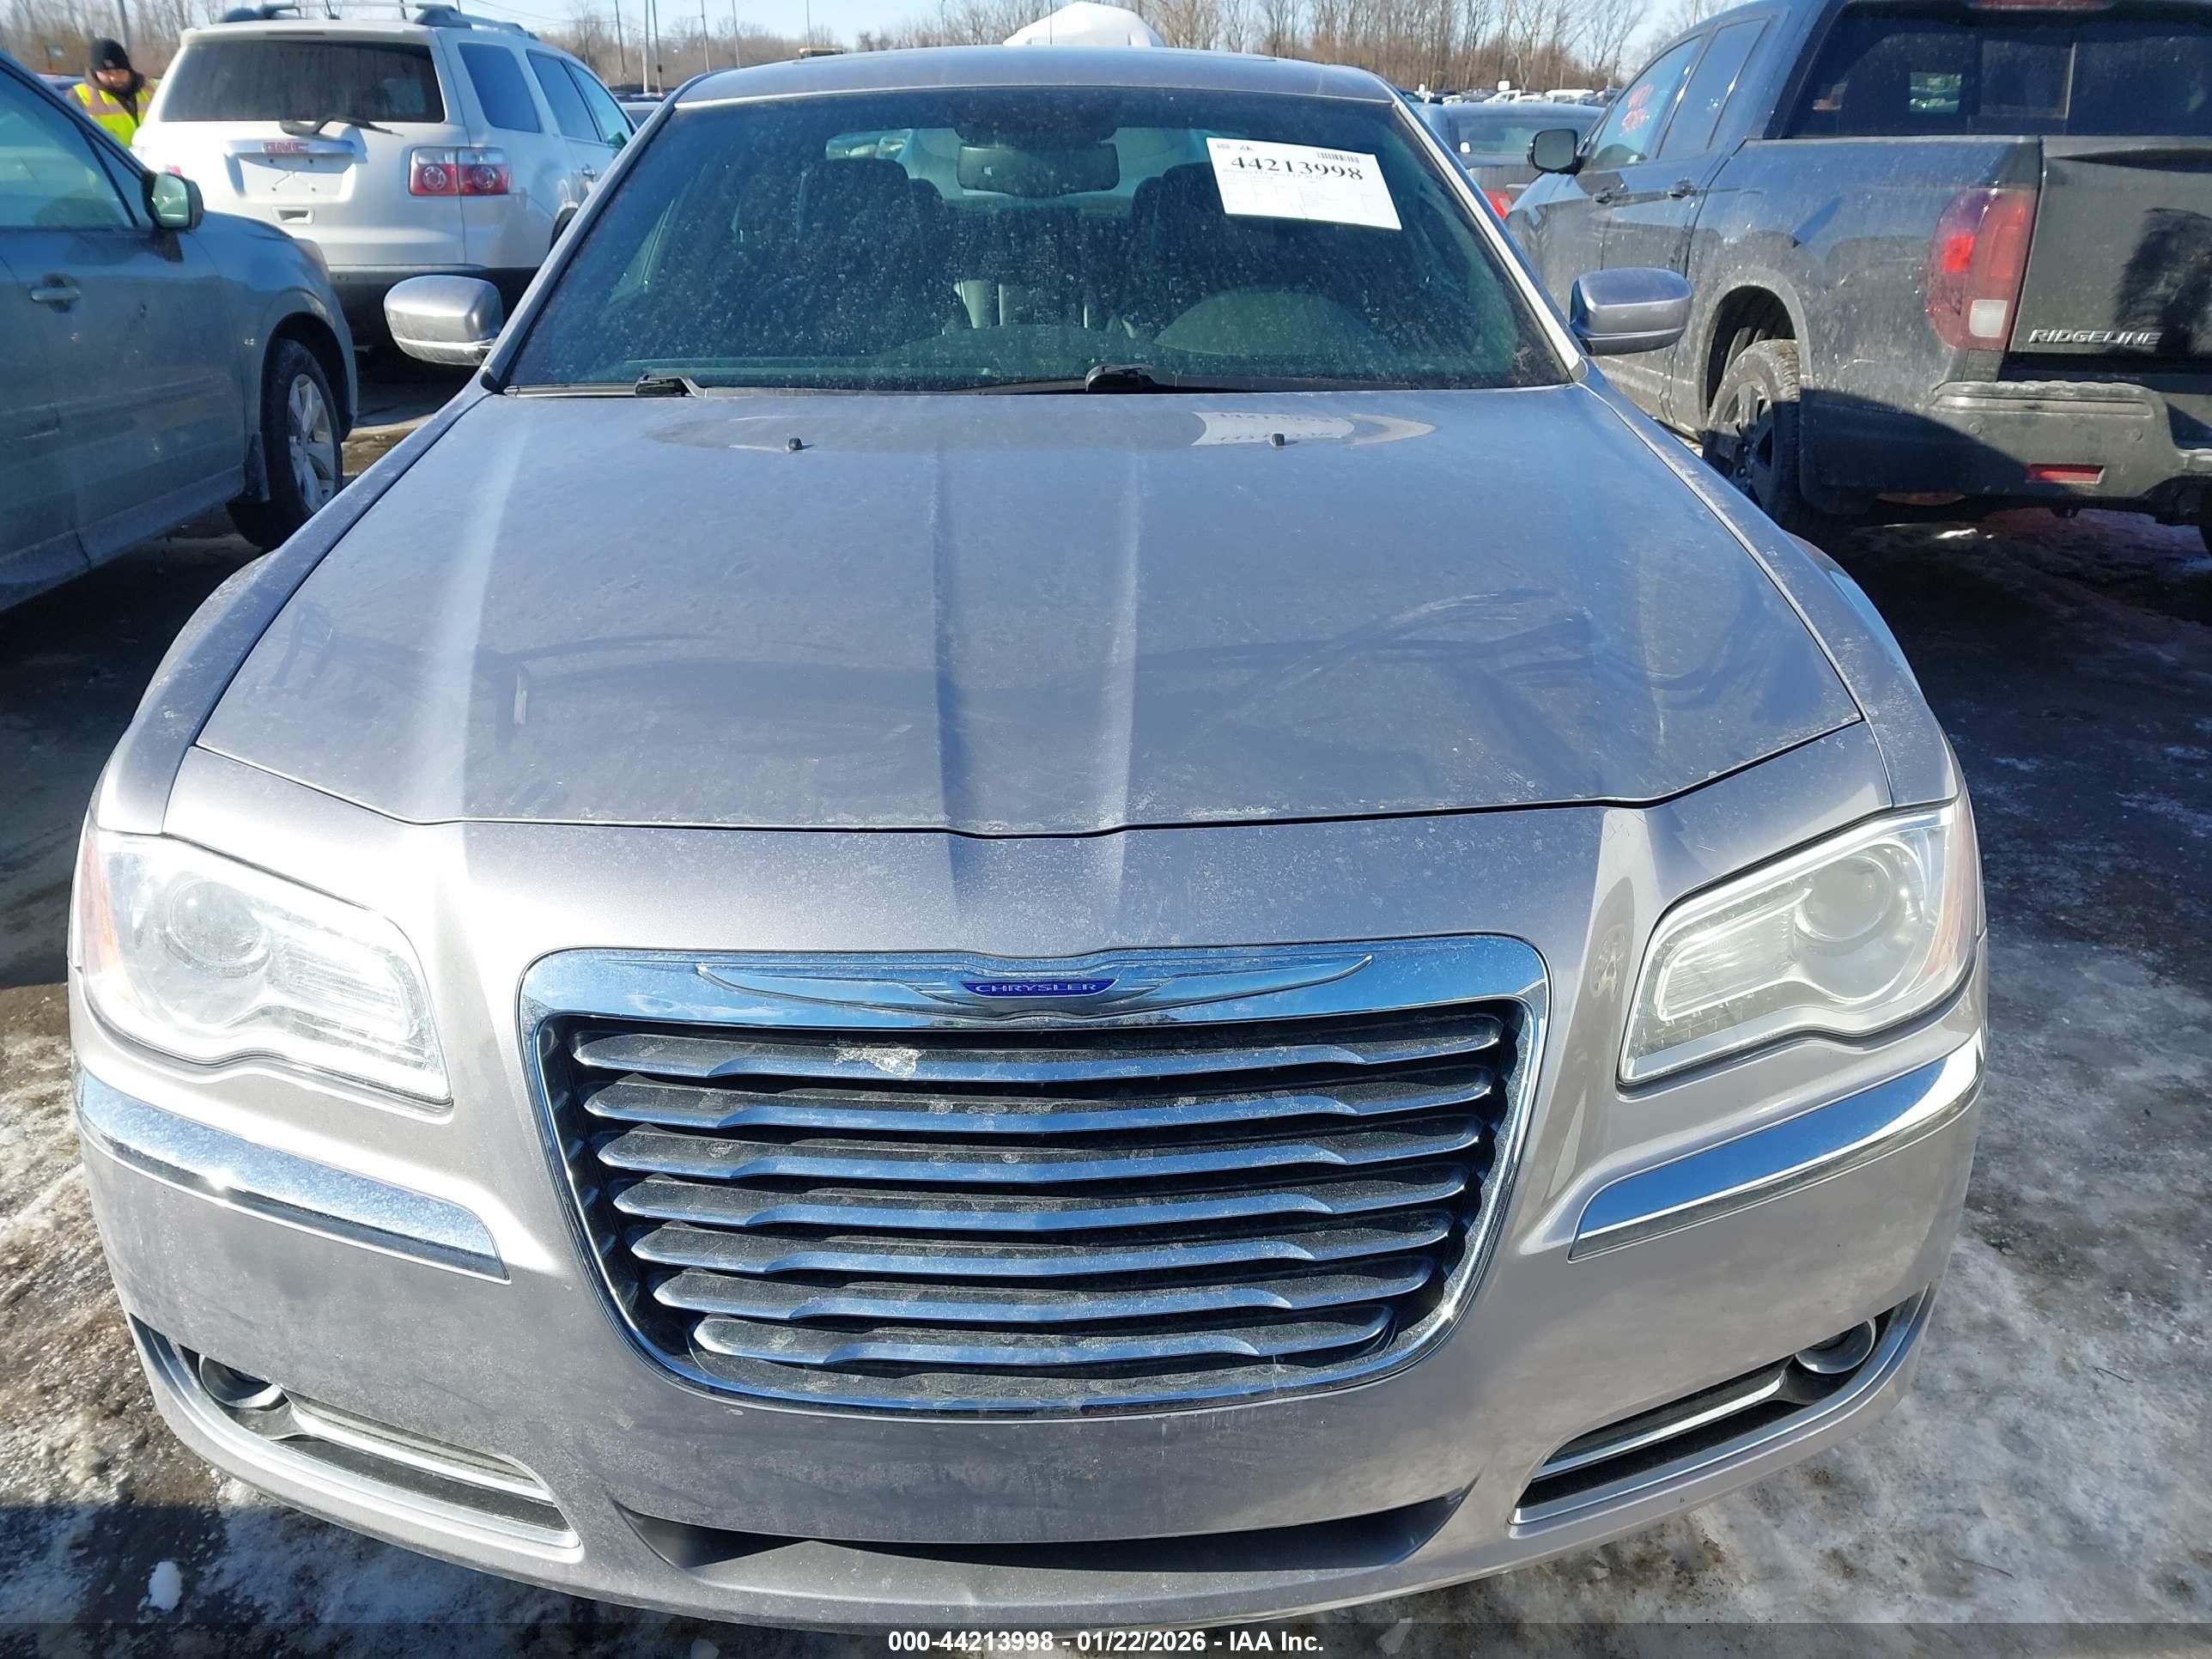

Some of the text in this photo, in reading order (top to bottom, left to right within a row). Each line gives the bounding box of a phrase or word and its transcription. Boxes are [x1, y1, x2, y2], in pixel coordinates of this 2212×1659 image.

[1231, 156, 1364, 181] 44213998
[2028, 329, 2164, 345] RIDGELINE
[975, 981, 1097, 994] CHRYSLER
